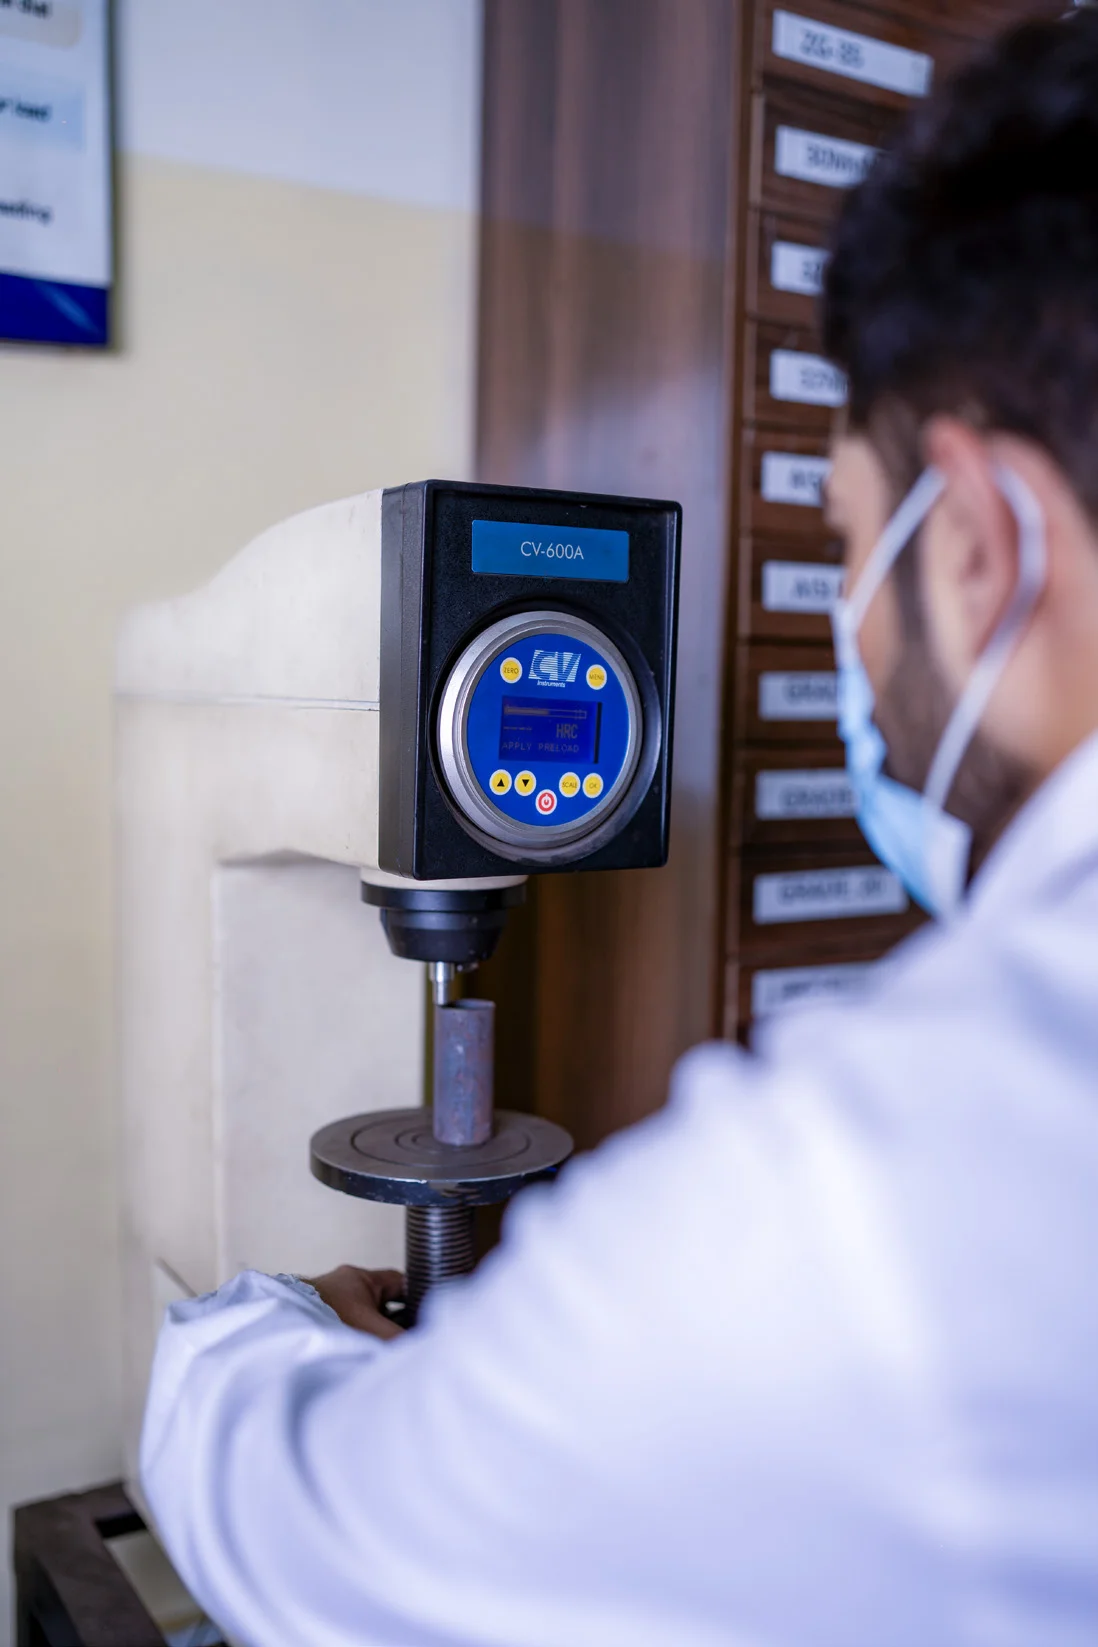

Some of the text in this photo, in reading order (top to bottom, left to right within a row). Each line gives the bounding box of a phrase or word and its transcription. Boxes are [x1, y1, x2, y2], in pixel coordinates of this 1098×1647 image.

[520, 541, 584, 560] CV-600A
[503, 667, 519, 675] ZERO
[589, 673, 604, 681] MENU
[536, 680, 566, 688] Instruments
[555, 723, 579, 739] HRC
[501, 741, 580, 753] APPLY PRELOAD
[562, 780, 577, 788] SCALE
